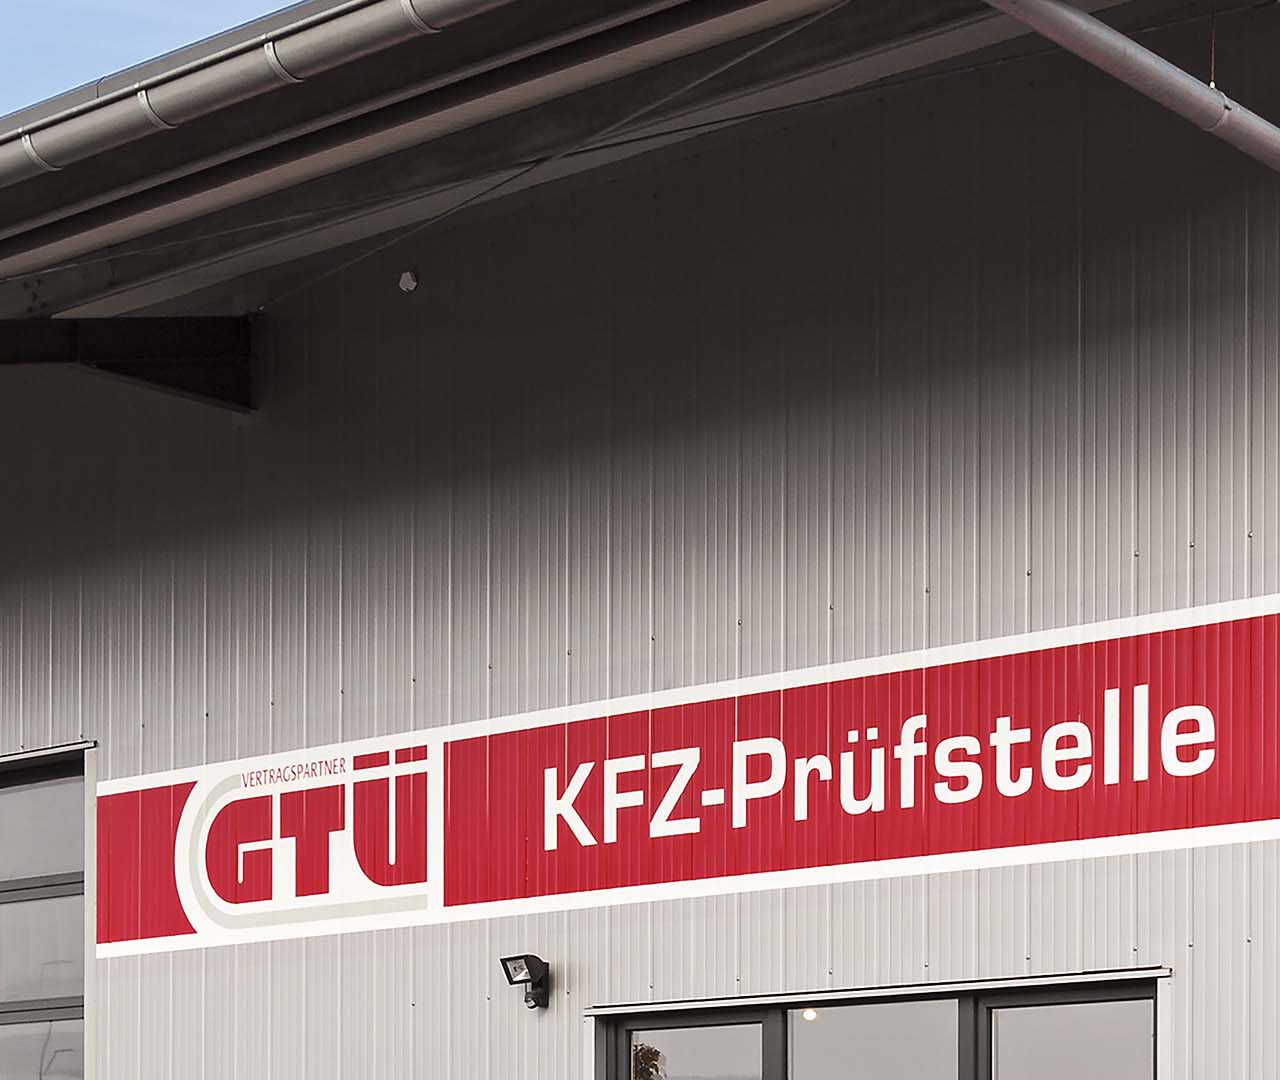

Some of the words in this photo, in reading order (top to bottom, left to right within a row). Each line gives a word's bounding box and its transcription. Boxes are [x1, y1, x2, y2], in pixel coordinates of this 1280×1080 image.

[205, 745, 428, 905] GTÜ
[241, 757, 346, 788] VERTRAGSPARTNER
[543, 683, 1216, 851] KFZ-Prüfstelle
